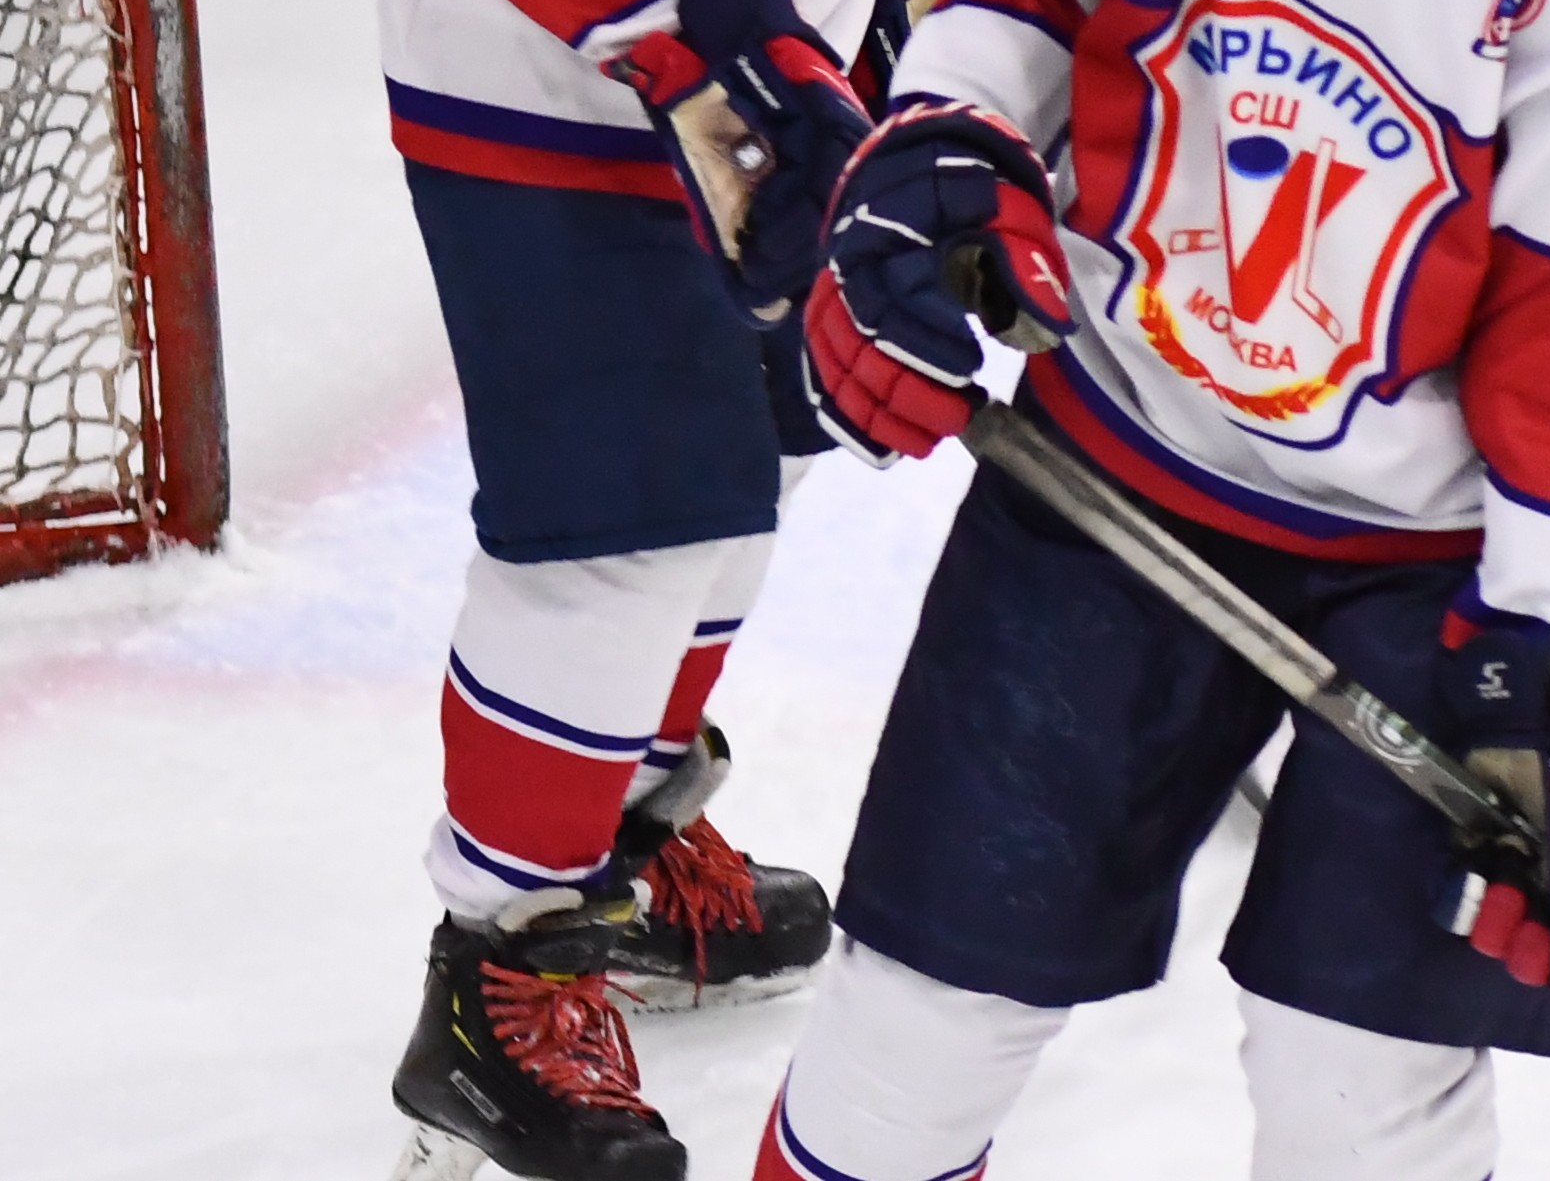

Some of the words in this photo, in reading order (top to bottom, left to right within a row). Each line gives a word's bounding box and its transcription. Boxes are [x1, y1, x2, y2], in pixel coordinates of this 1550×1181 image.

[1187, 22, 1412, 160] РЬИНО
[1229, 90, 1301, 131] СШ
[1184, 286, 1299, 372] МОКВА
